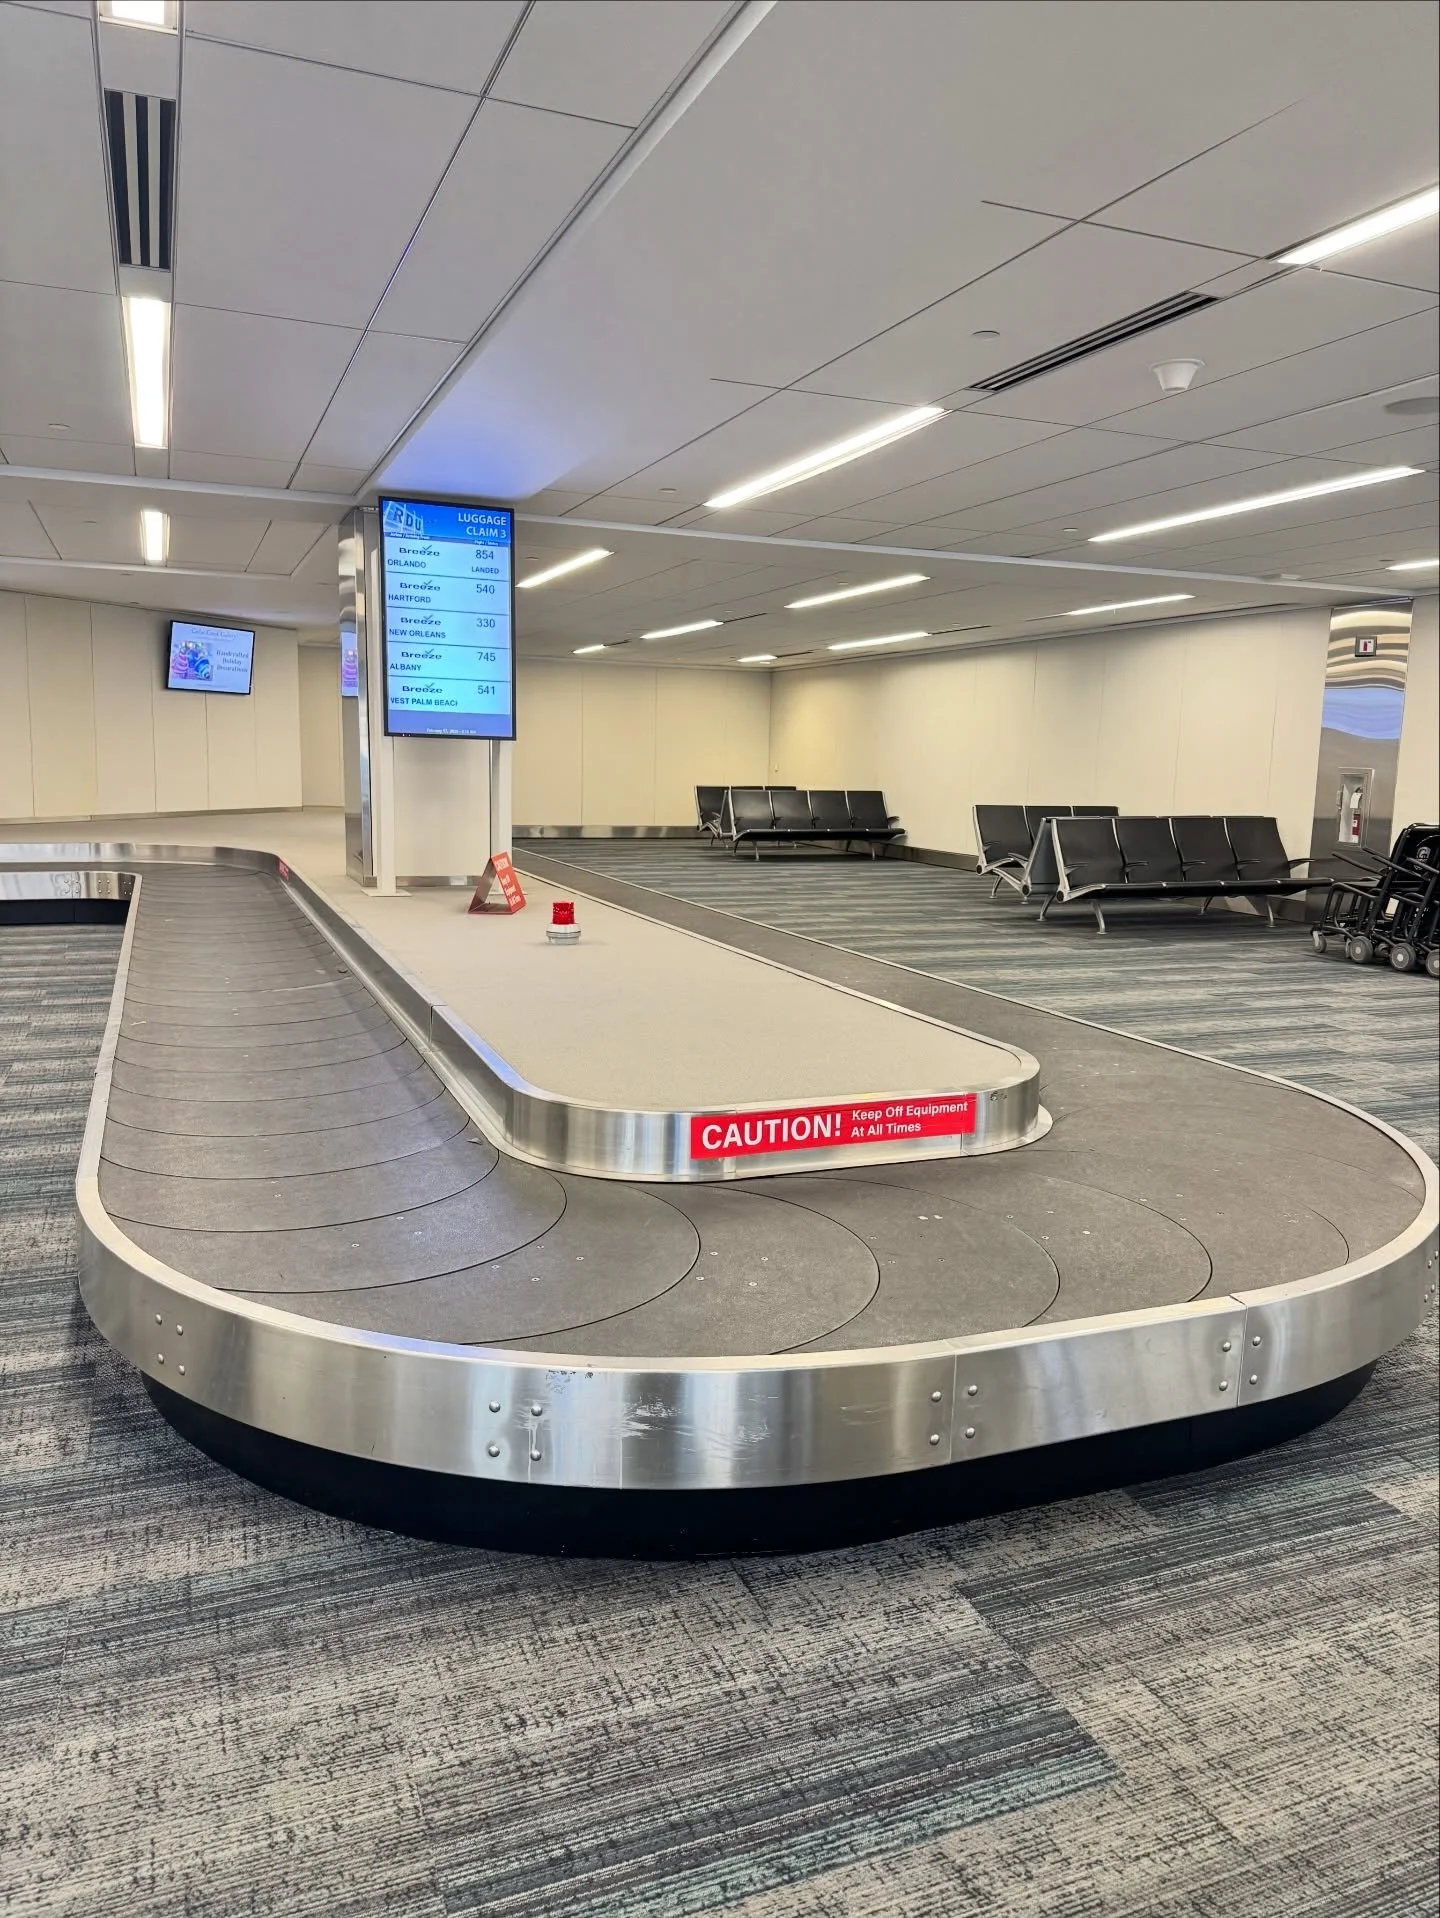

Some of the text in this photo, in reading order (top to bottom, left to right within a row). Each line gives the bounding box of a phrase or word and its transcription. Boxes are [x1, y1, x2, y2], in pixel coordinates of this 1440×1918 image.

[393, 506, 423, 531] RDU
[457, 512, 507, 526] LUGGAGE
[466, 526, 507, 538] CLAIM 3
[399, 546, 440, 557] Breeze
[475, 549, 494, 560] 854
[387, 559, 426, 568] ORLANDO
[471, 566, 500, 575] LANDED
[399, 581, 441, 592] Breeze
[476, 584, 495, 594] 540
[388, 594, 431, 603] HARTFORD
[400, 616, 442, 626] Breeze
[476, 618, 496, 628] 330
[409, 630, 446, 639] ORLEANS
[401, 650, 442, 660] Breeze
[477, 652, 496, 662] 745
[389, 663, 422, 671] ALBANY
[402, 685, 443, 694] Breeze
[477, 685, 495, 695] 541
[852, 1101, 968, 1121] Keep Off Equipment
[701, 1112, 841, 1150] CAUTION!
[851, 1122, 921, 1138] At All Times
